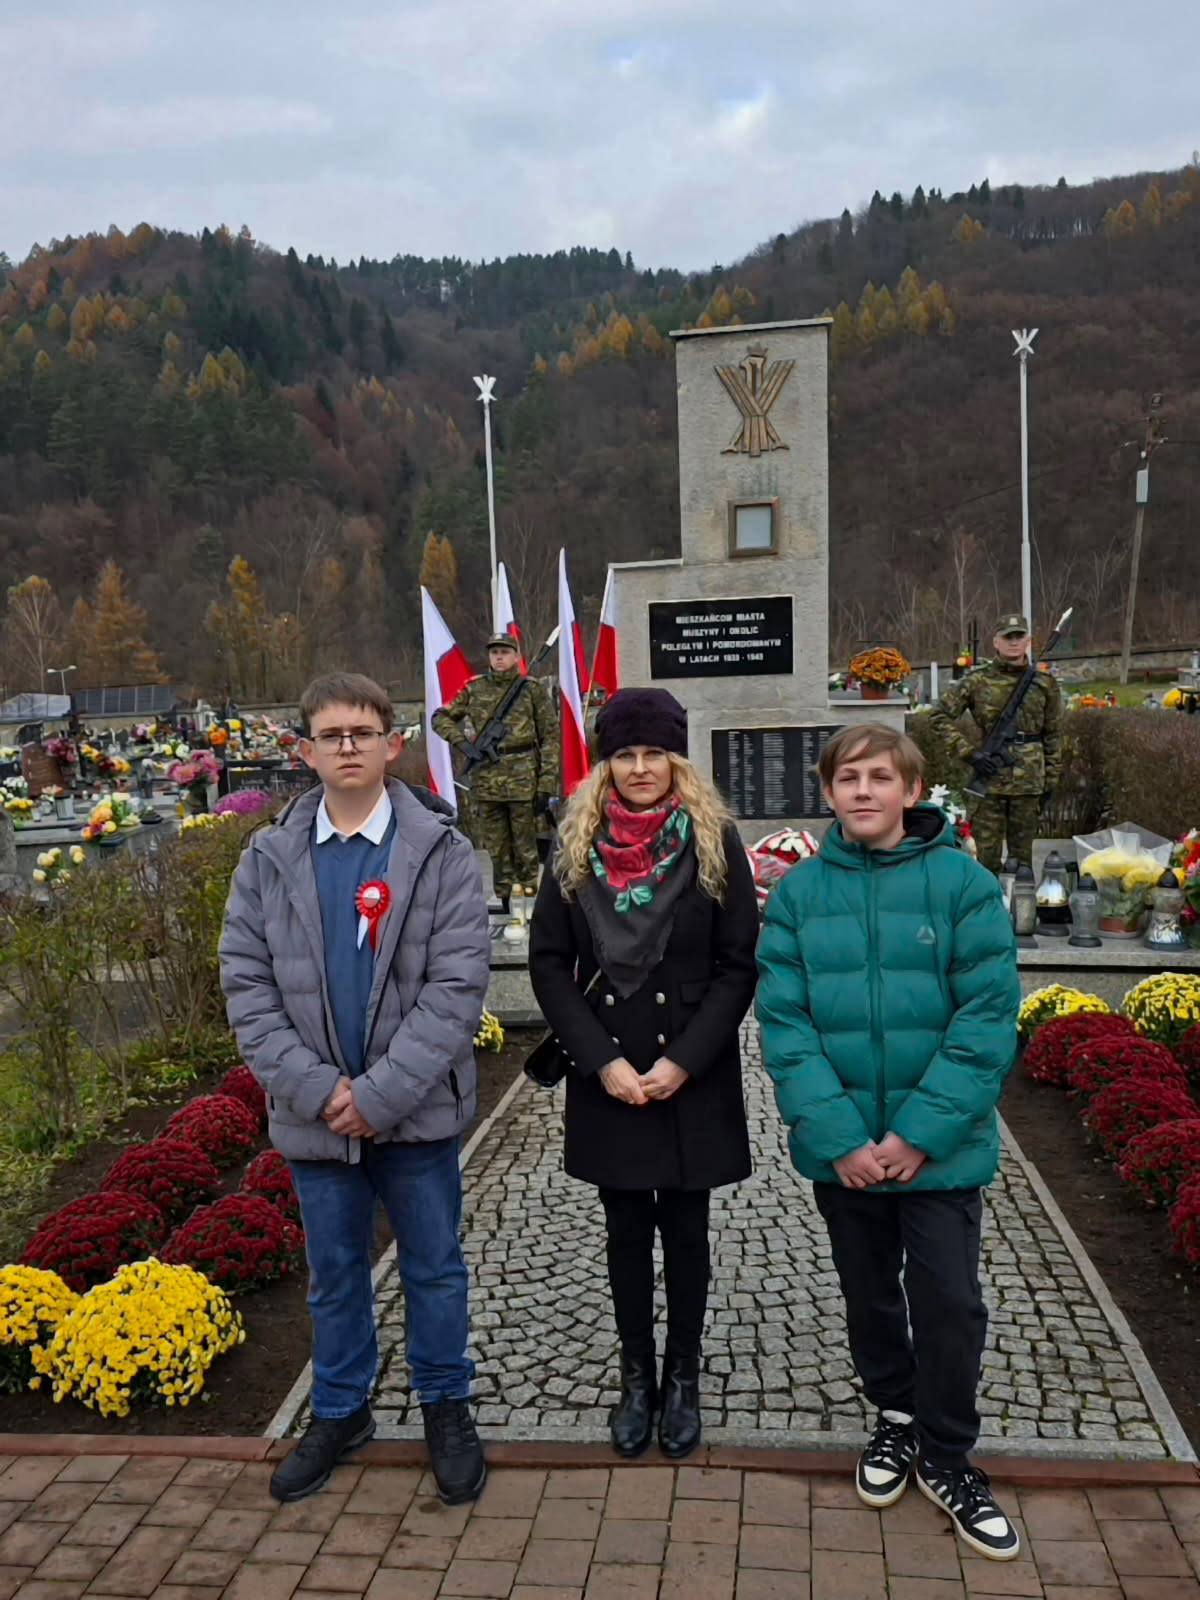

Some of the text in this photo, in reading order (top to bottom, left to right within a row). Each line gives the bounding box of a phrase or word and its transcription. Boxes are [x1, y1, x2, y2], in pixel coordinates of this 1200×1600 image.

[736, 612, 765, 621] MIASTA
[682, 628, 719, 637] MUSZYNY
[729, 626, 759, 635] OKOLIC
[712, 639, 781, 649] POMORDOWANYM
[679, 655, 686, 664] W
[690, 654, 719, 663] LATACH
